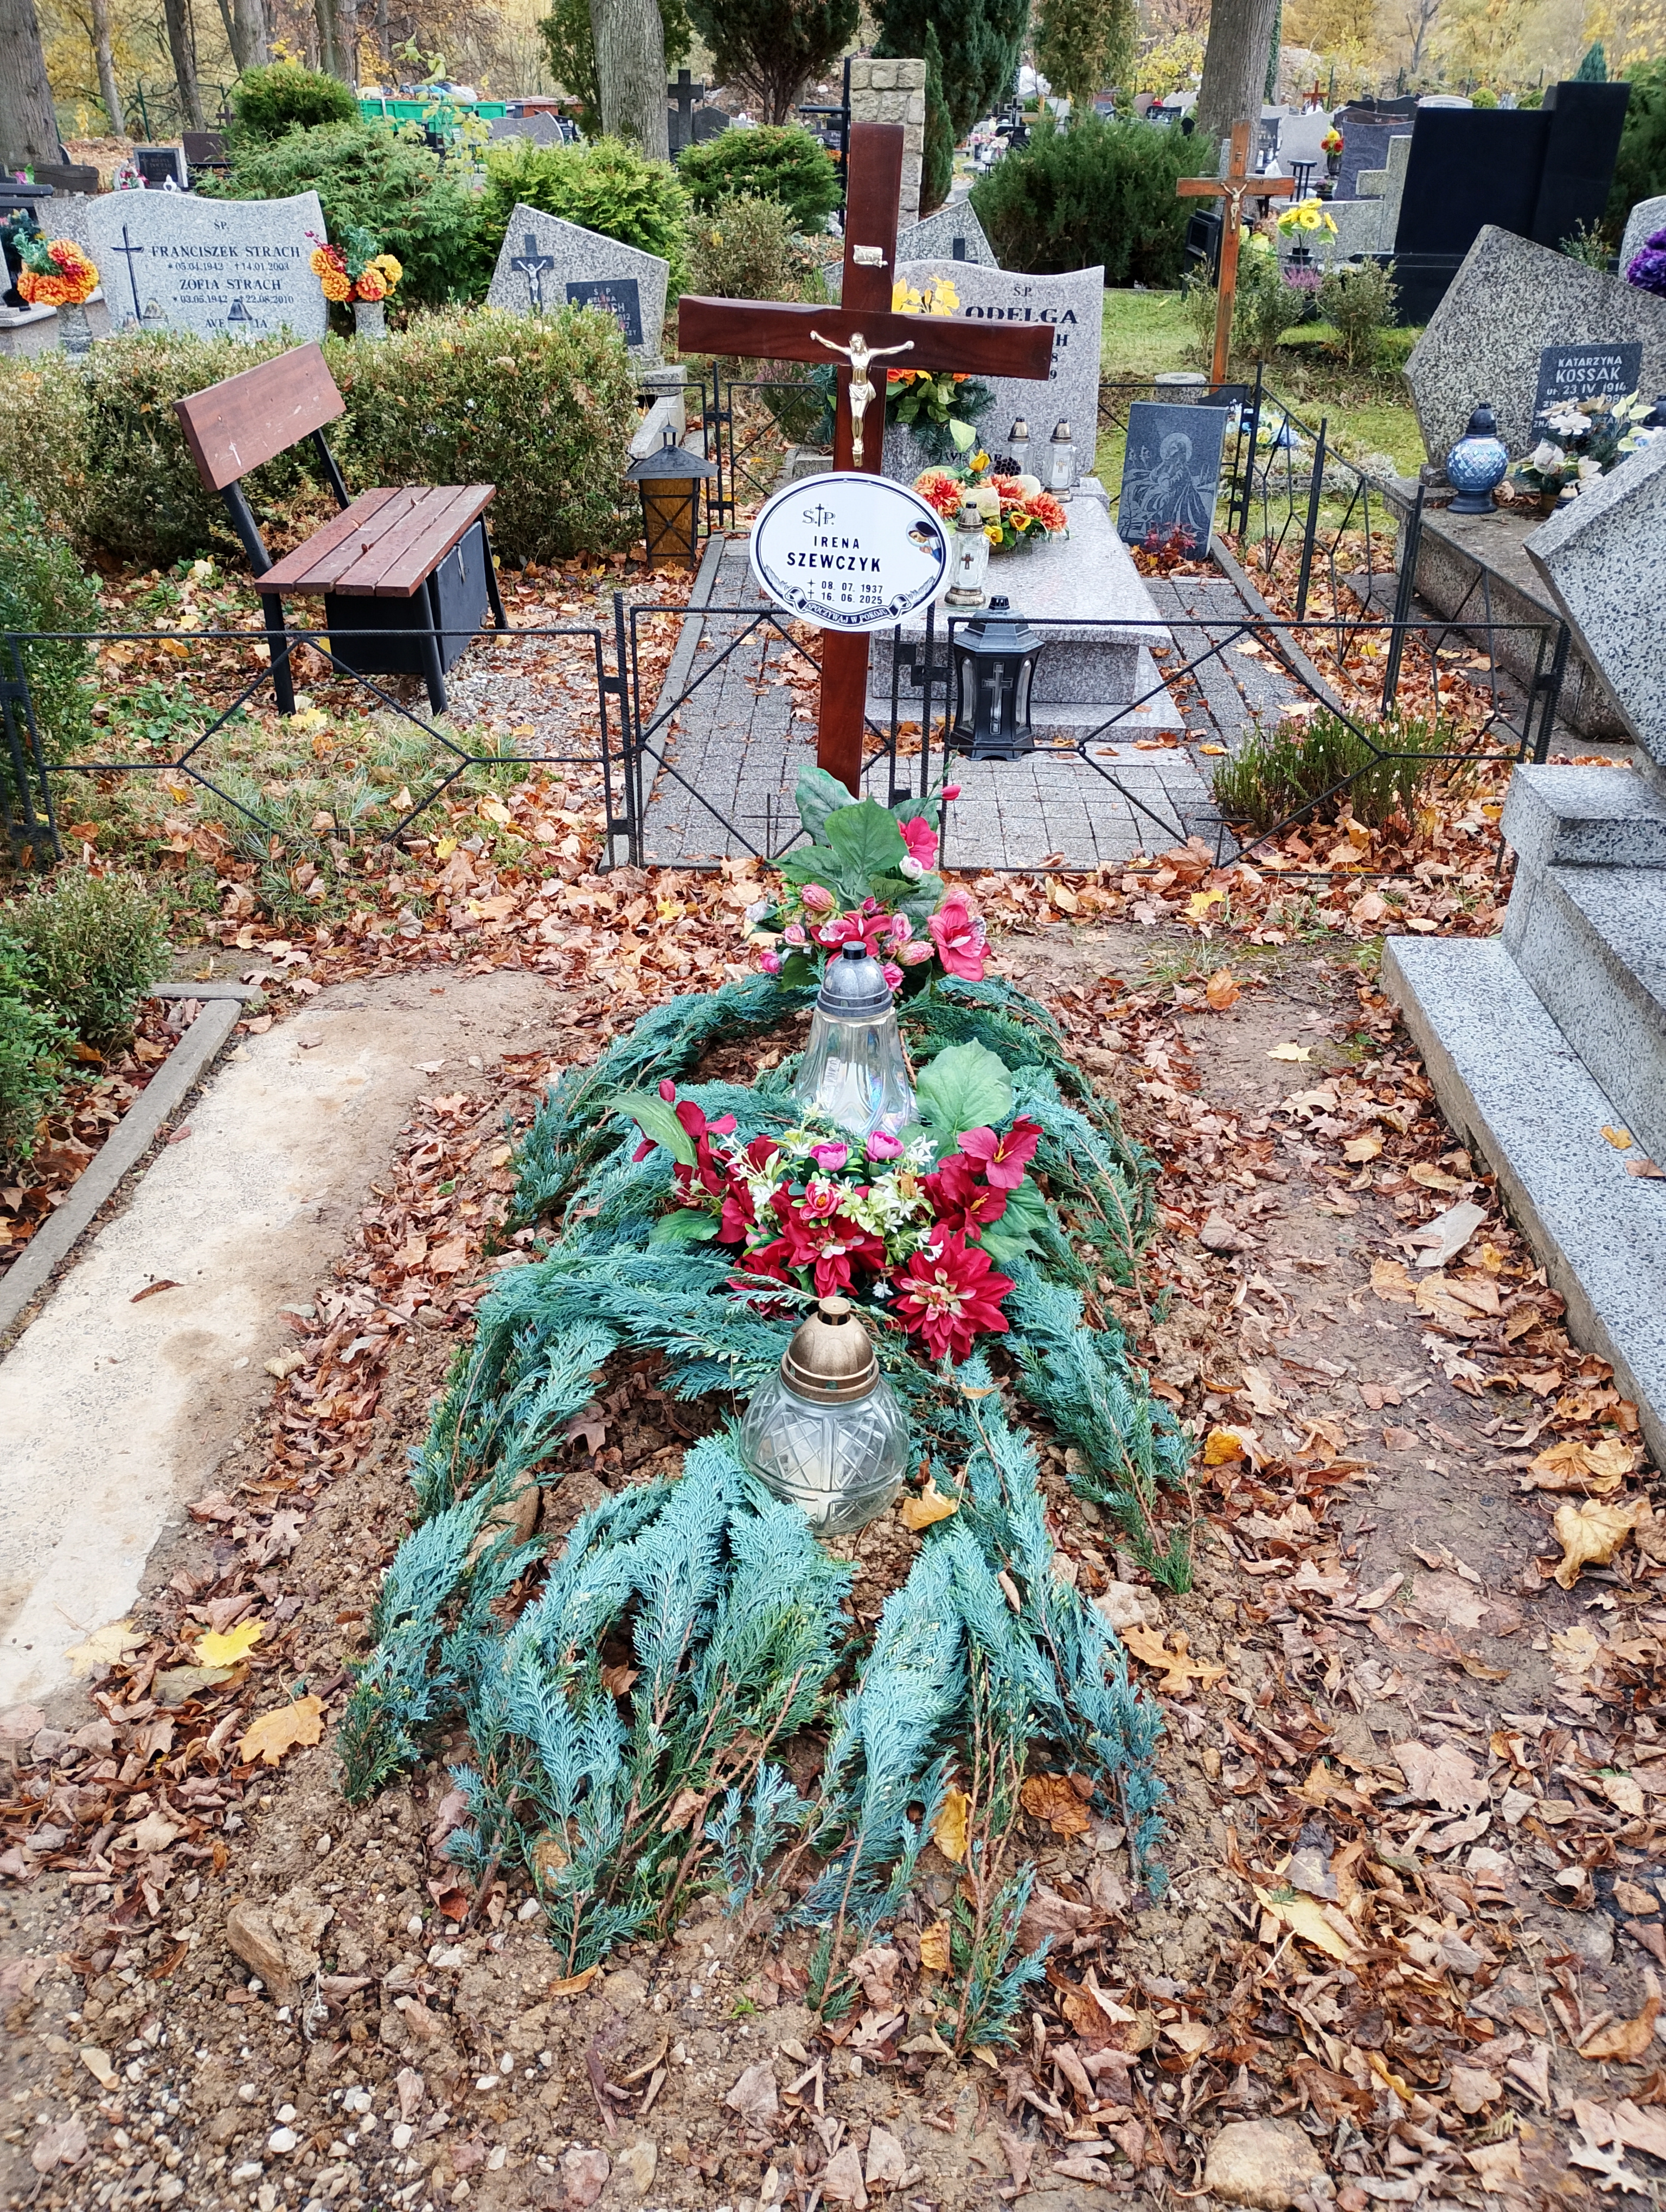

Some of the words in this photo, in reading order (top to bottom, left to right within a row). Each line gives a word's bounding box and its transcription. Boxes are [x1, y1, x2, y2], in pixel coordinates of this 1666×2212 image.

[152, 246, 238, 257] FRANCISZEK
[245, 246, 300, 258] STRACH
[180, 279, 220, 290] ZOFIA
[226, 279, 281, 290] STRACH
[206, 319, 225, 328] AVE
[1558, 356, 1622, 367] KATARZYNA
[1556, 366, 1621, 383] KOSSAK
[1562, 384, 1577, 395] 23
[1582, 383, 1597, 394] IV
[1603, 382, 1626, 393] 1914
[814, 536, 860, 549] IRENA
[786, 552, 881, 572] SZEWCZYK
[861, 584, 883, 594] 1937
[860, 595, 882, 605] 2025
[806, 603, 848, 623] SPOCZYWAJ
[859, 608, 888, 623] POKOJU
